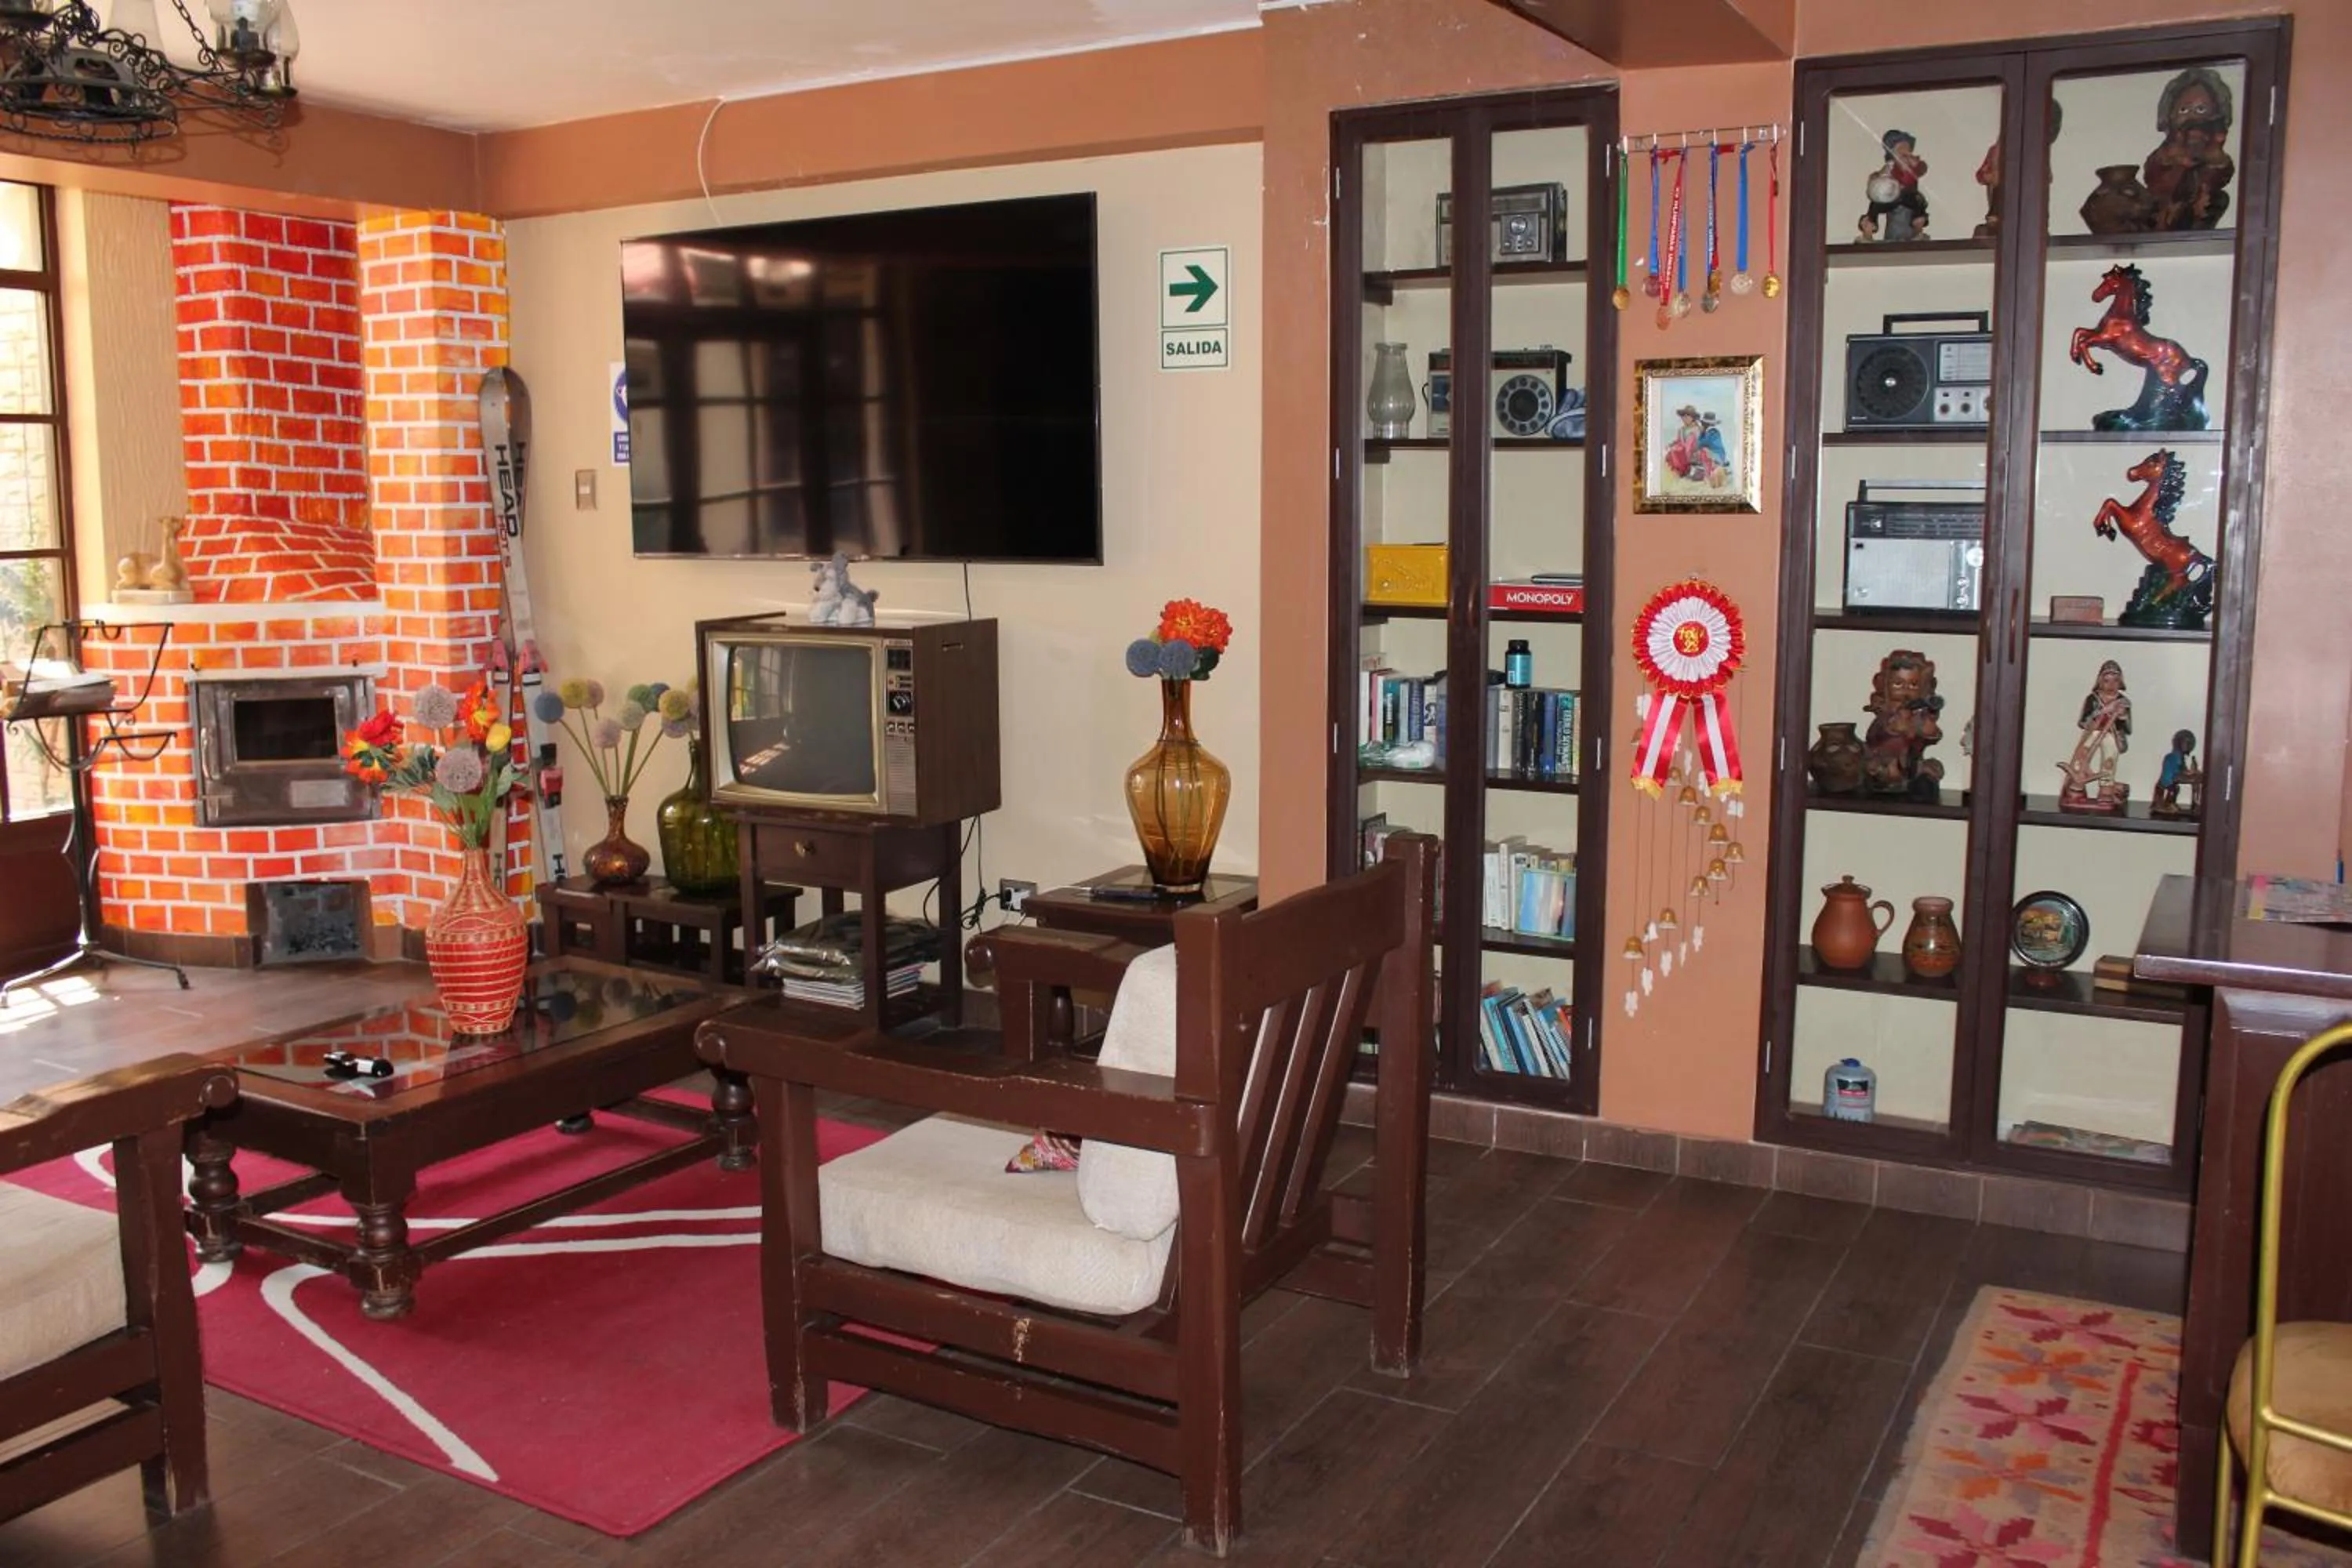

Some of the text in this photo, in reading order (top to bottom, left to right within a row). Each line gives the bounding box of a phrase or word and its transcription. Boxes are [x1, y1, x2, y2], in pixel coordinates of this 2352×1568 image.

[1166, 340, 1222, 355] SALIDA
[495, 445, 518, 537] HEAD
[1506, 592, 1573, 604] MONOPOLY
